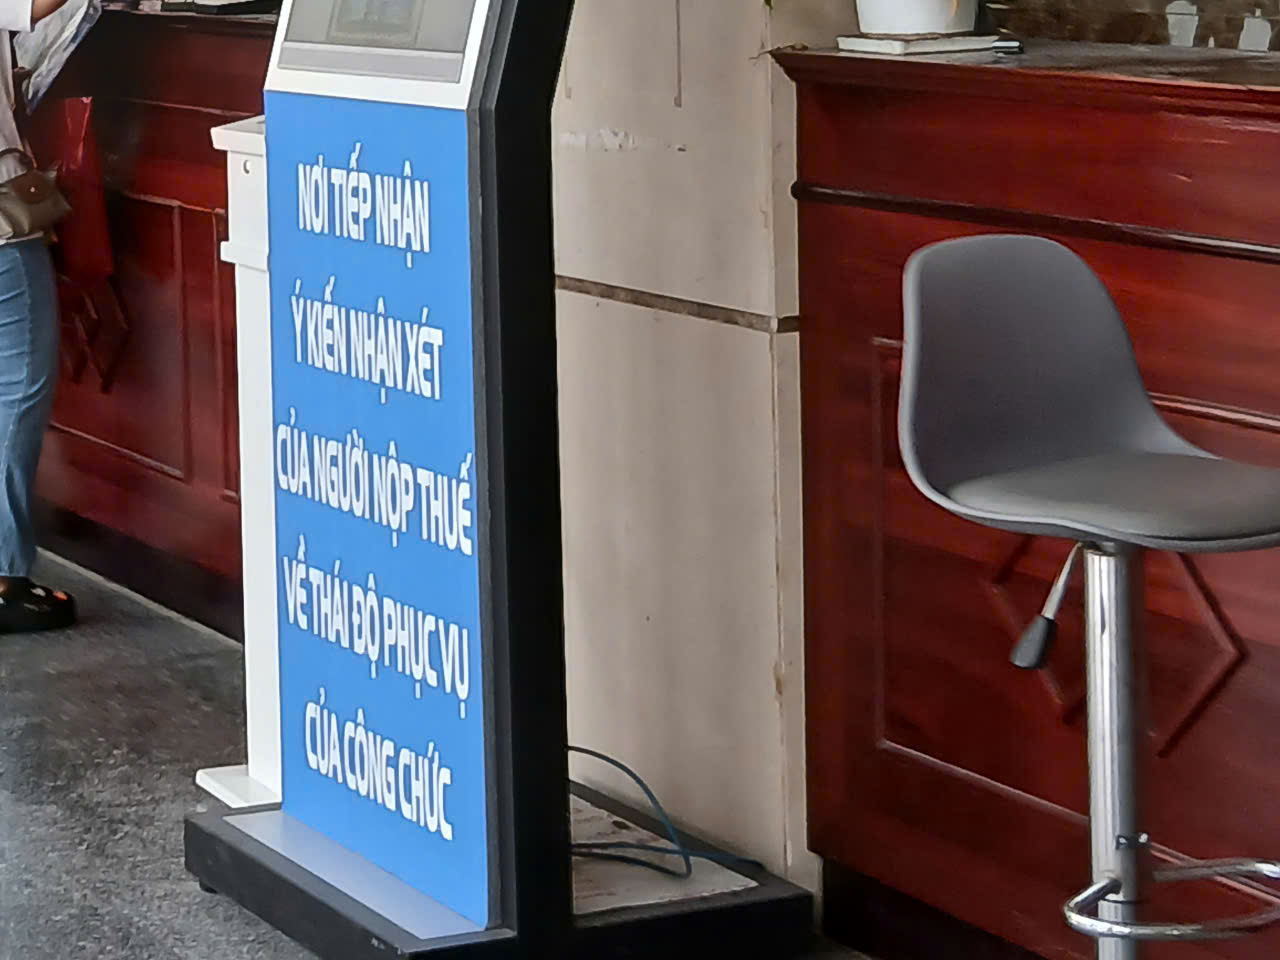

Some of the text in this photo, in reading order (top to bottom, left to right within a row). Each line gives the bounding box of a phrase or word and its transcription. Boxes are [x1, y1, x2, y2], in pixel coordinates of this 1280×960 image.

[297, 141, 430, 269] NƠI TIẾP NHẬN
[291, 275, 444, 405] Ý KIẾN NHẬN XÉT
[276, 406, 474, 557] CỦA NGƯỜI NỘP THUẾ
[283, 534, 470, 720] VỀ THÁI ĐỘ PHỤC VỤ
[305, 686, 454, 842] CỦA CÔNG CHỨC
